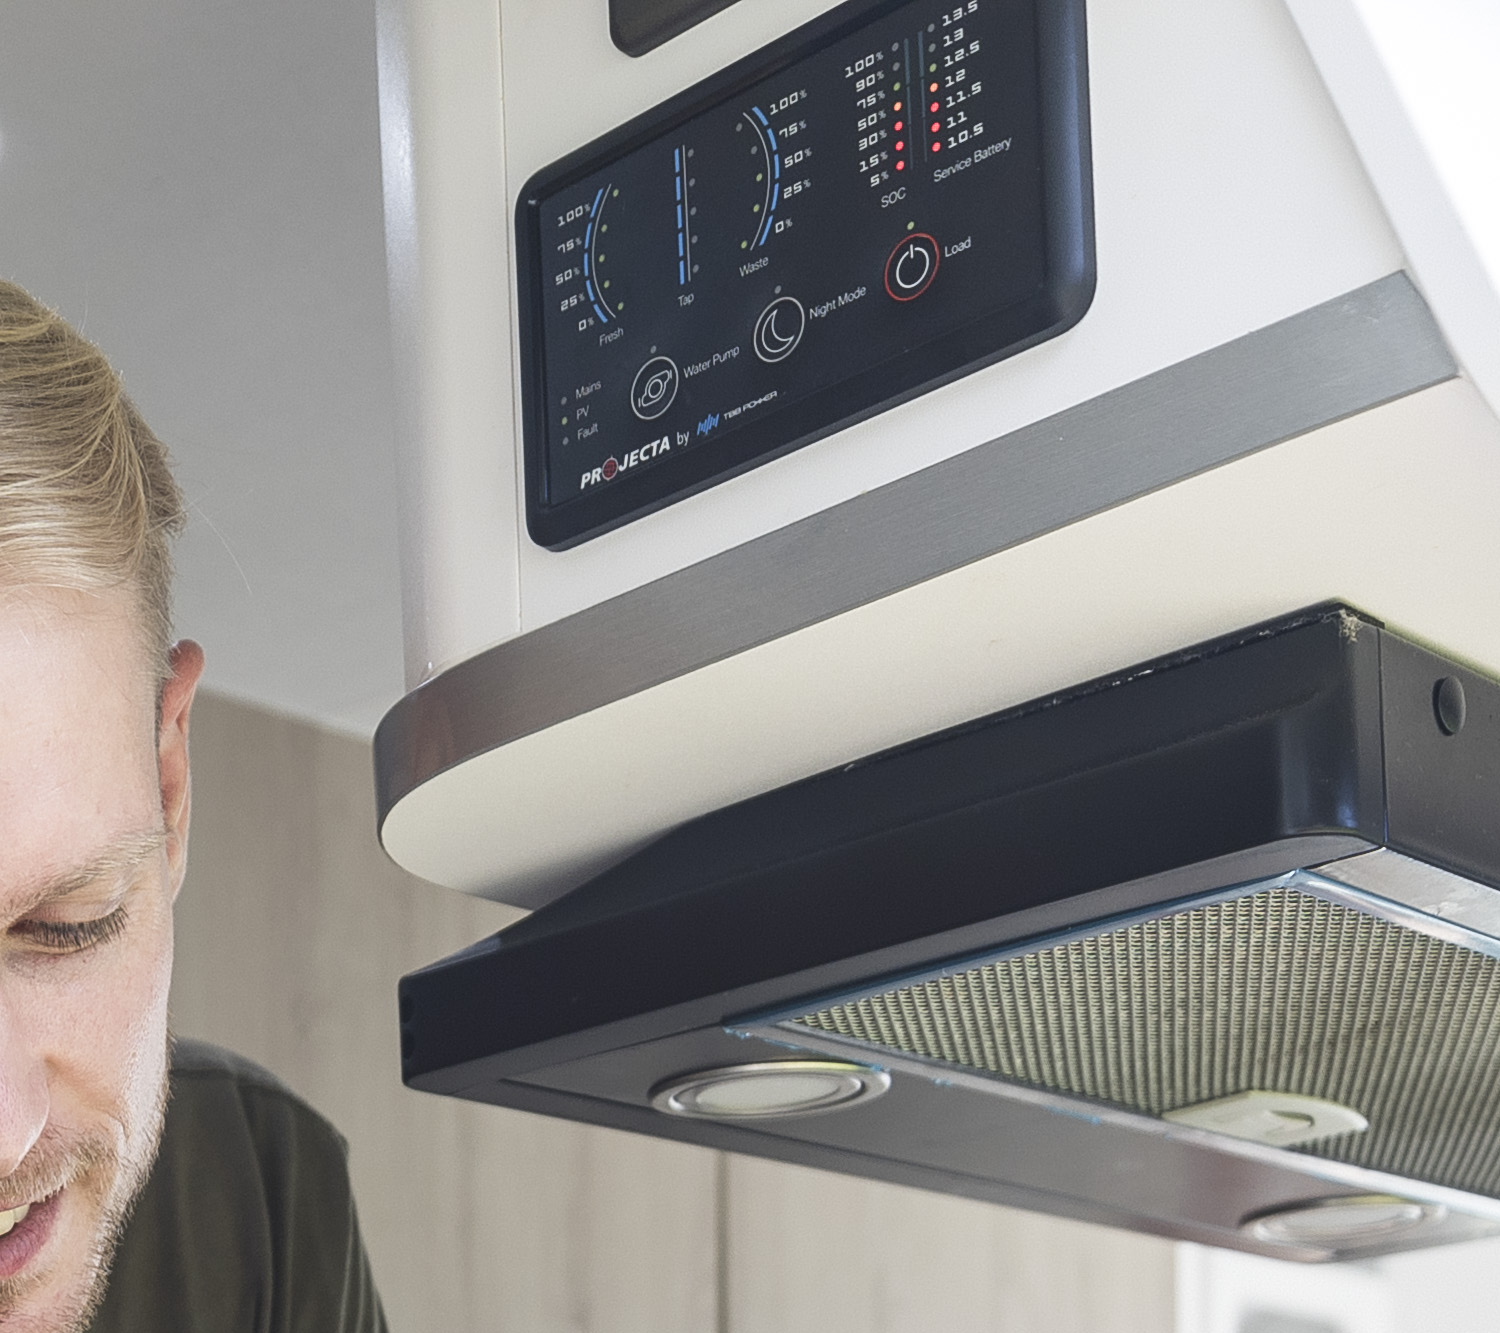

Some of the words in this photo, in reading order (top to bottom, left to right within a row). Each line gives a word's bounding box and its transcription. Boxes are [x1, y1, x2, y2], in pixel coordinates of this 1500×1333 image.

[942, 0, 978, 27] 13.5
[943, 28, 964, 47] 13
[944, 40, 980, 67] 12.5
[845, 51, 884, 79] 100%
[856, 70, 885, 93] 90%
[945, 68, 966, 88] 12
[769, 89, 808, 116] 100%
[857, 90, 886, 109] 75%
[946, 81, 982, 108] 11.5
[779, 120, 807, 139] 75%
[858, 109, 887, 132] 50%
[947, 111, 967, 129] 11
[858, 129, 888, 151] 30%
[948, 122, 984, 149] 10.5
[784, 147, 813, 169] 50%
[859, 151, 889, 173] 15%
[934, 158, 971, 183] Service
[974, 137, 1012, 163] Battery
[783, 179, 812, 200] 25%
[870, 170, 889, 188] 5%
[881, 187, 907, 208] SOC
[557, 203, 591, 227] 100%
[775, 218, 793, 234] 0%
[557, 237, 582, 254] 75%
[944, 236, 972, 258] Load
[555, 267, 581, 286] 50%
[739, 256, 769, 278] Waste
[560, 293, 585, 312] 25%
[678, 293, 695, 308] Tap
[809, 300, 837, 320] Night
[837, 285, 867, 307] Mode
[578, 317, 595, 332] 0%
[599, 327, 624, 347] Fresh
[683, 359, 710, 379] Water
[712, 345, 740, 368] Pump
[576, 380, 601, 400] Mains
[576, 405, 590, 420] PV
[577, 422, 598, 441] Fault
[580, 436, 670, 490] PROJECTA
[676, 431, 690, 446] by
